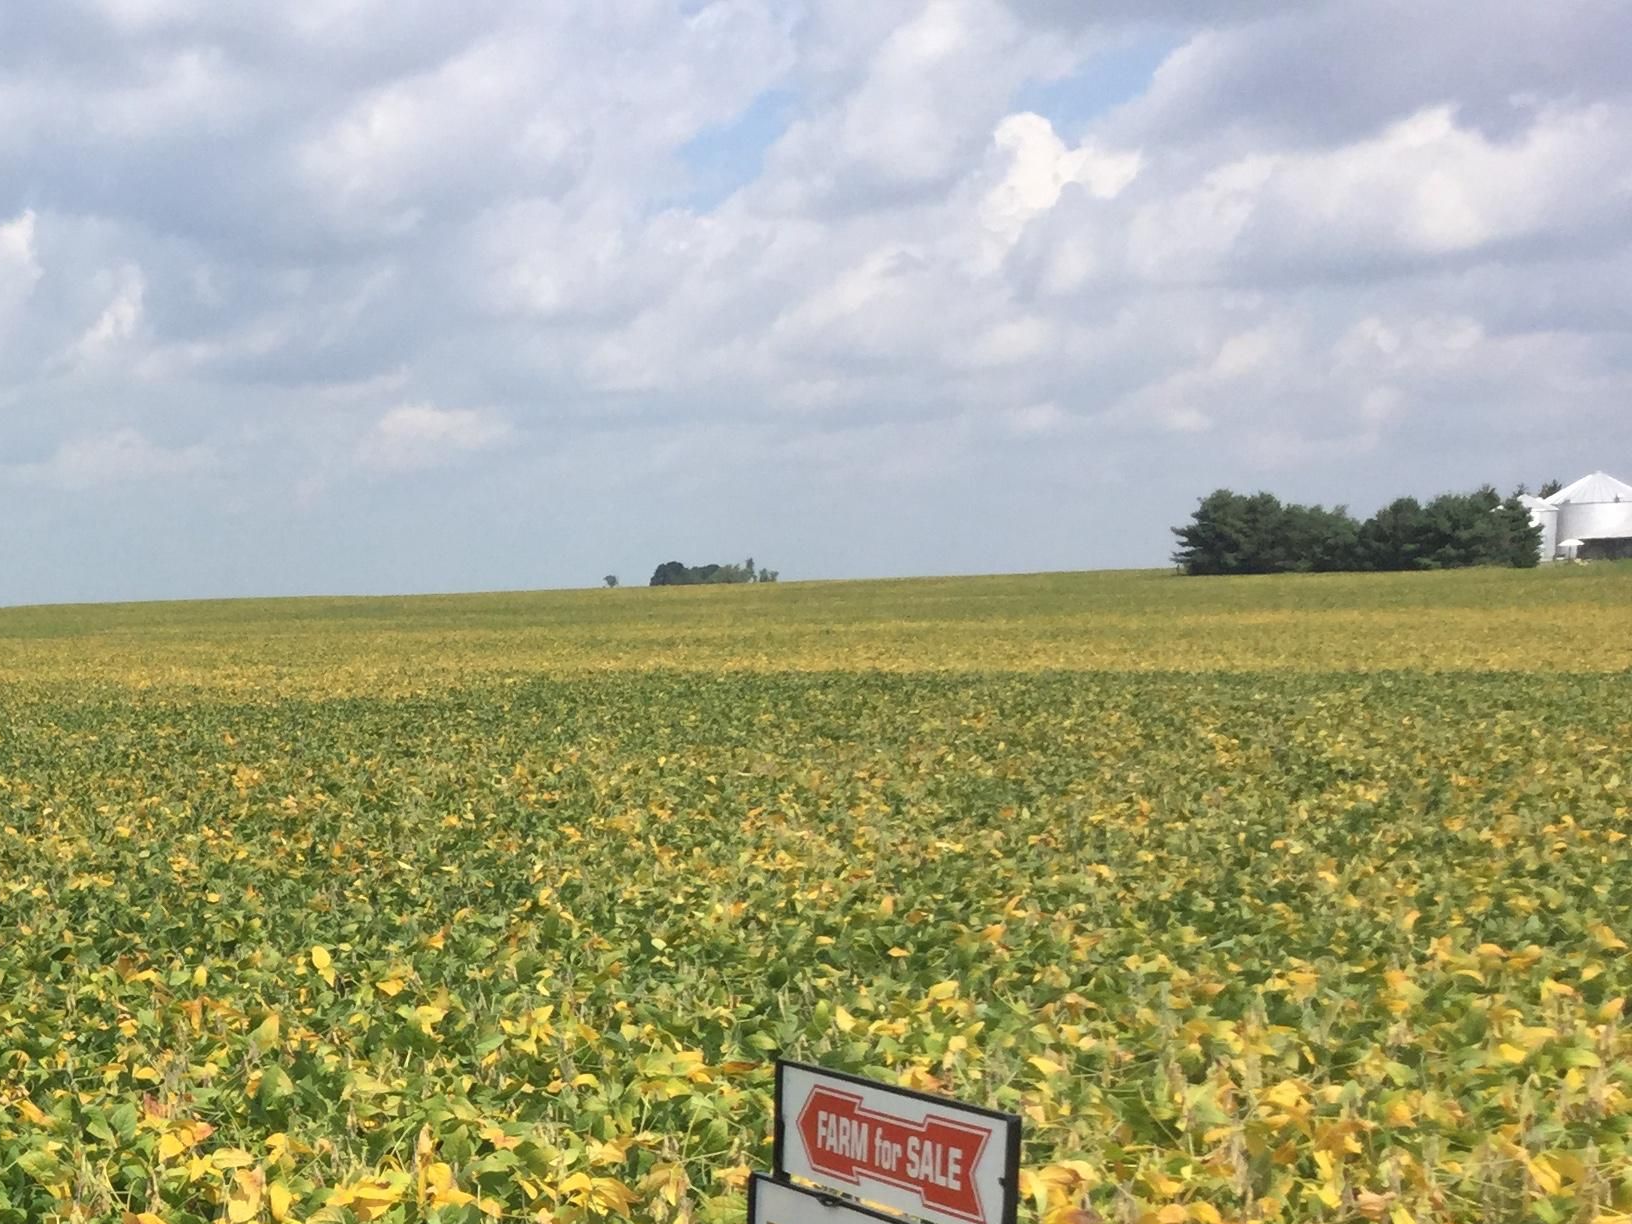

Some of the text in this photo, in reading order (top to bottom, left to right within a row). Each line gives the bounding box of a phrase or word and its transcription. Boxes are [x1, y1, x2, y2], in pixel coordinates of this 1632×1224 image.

[817, 1110, 962, 1191] FARM for SALE
